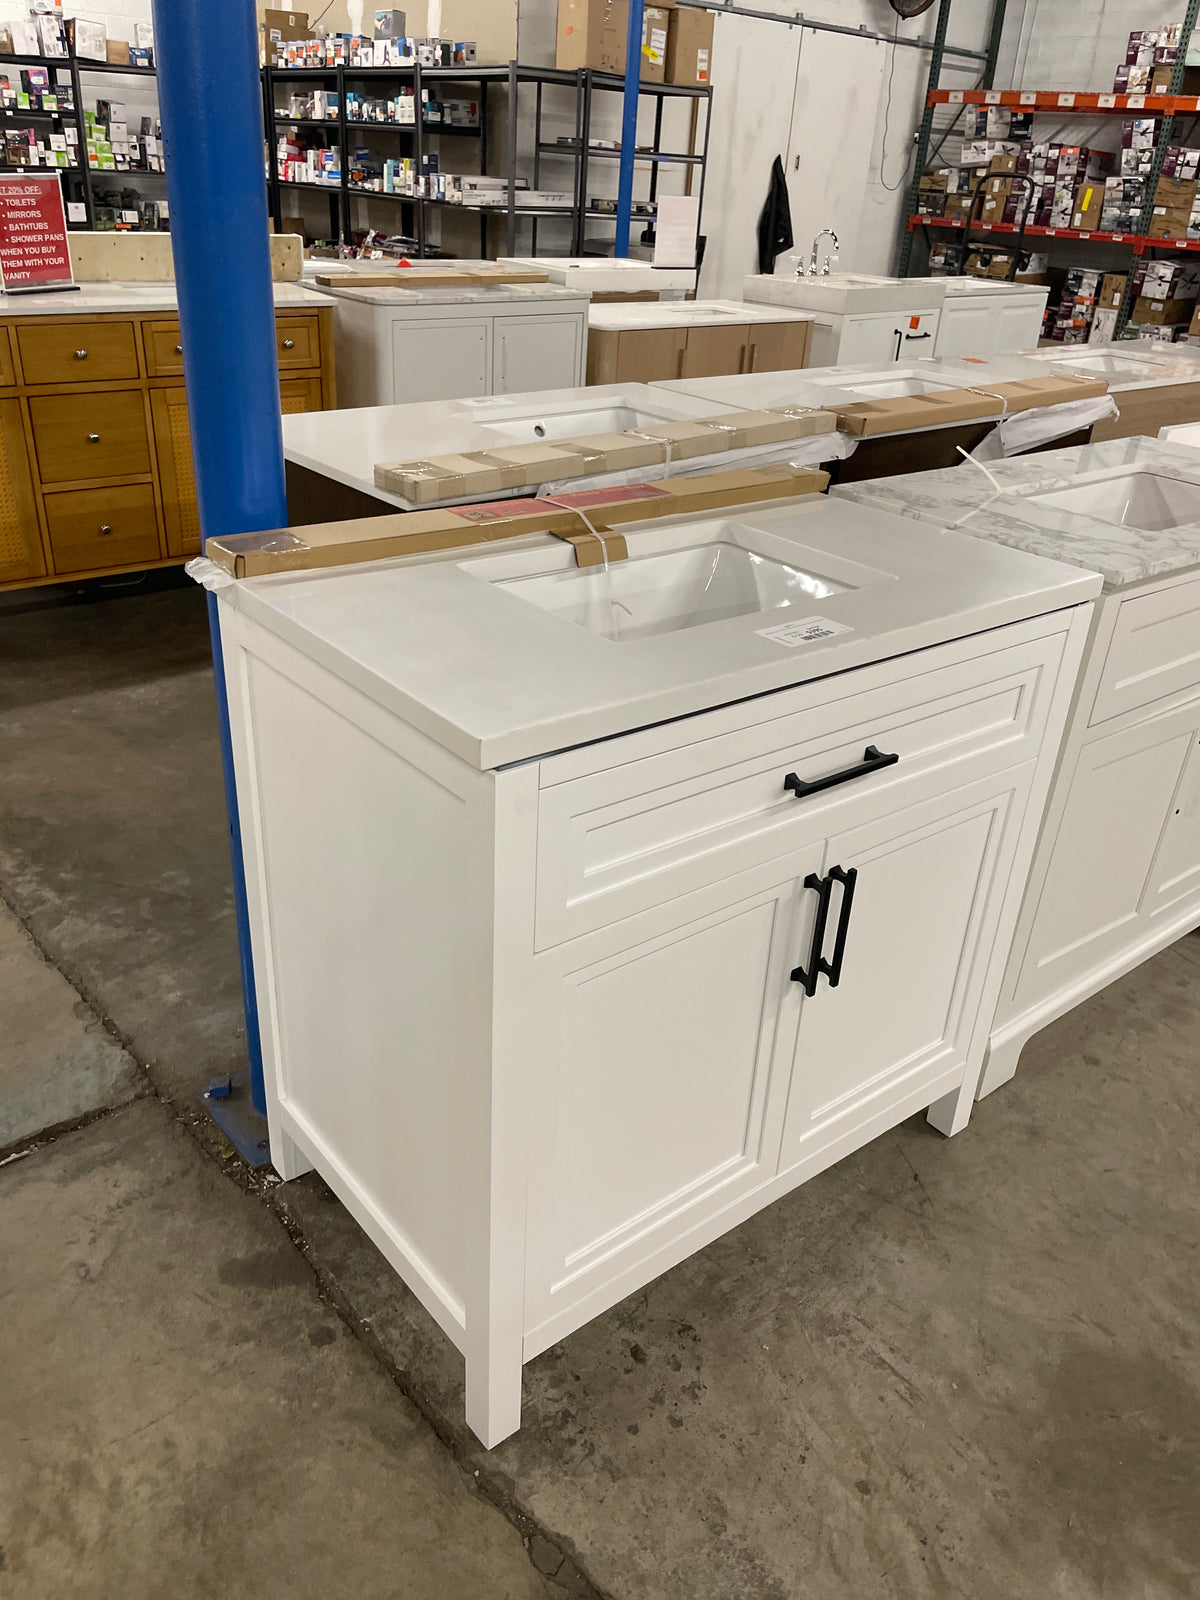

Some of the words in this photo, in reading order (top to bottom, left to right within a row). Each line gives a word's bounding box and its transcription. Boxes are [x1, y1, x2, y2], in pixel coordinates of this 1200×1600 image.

[8, 186, 23, 194] 20%
[9, 223, 49, 231] BATHTUBS
[11, 235, 43, 243] SHOWER
[1, 248, 23, 256] WHEN
[2, 260, 23, 268] THEM
[44, 257, 65, 265] YOUR
[4, 272, 31, 280] VANITY
